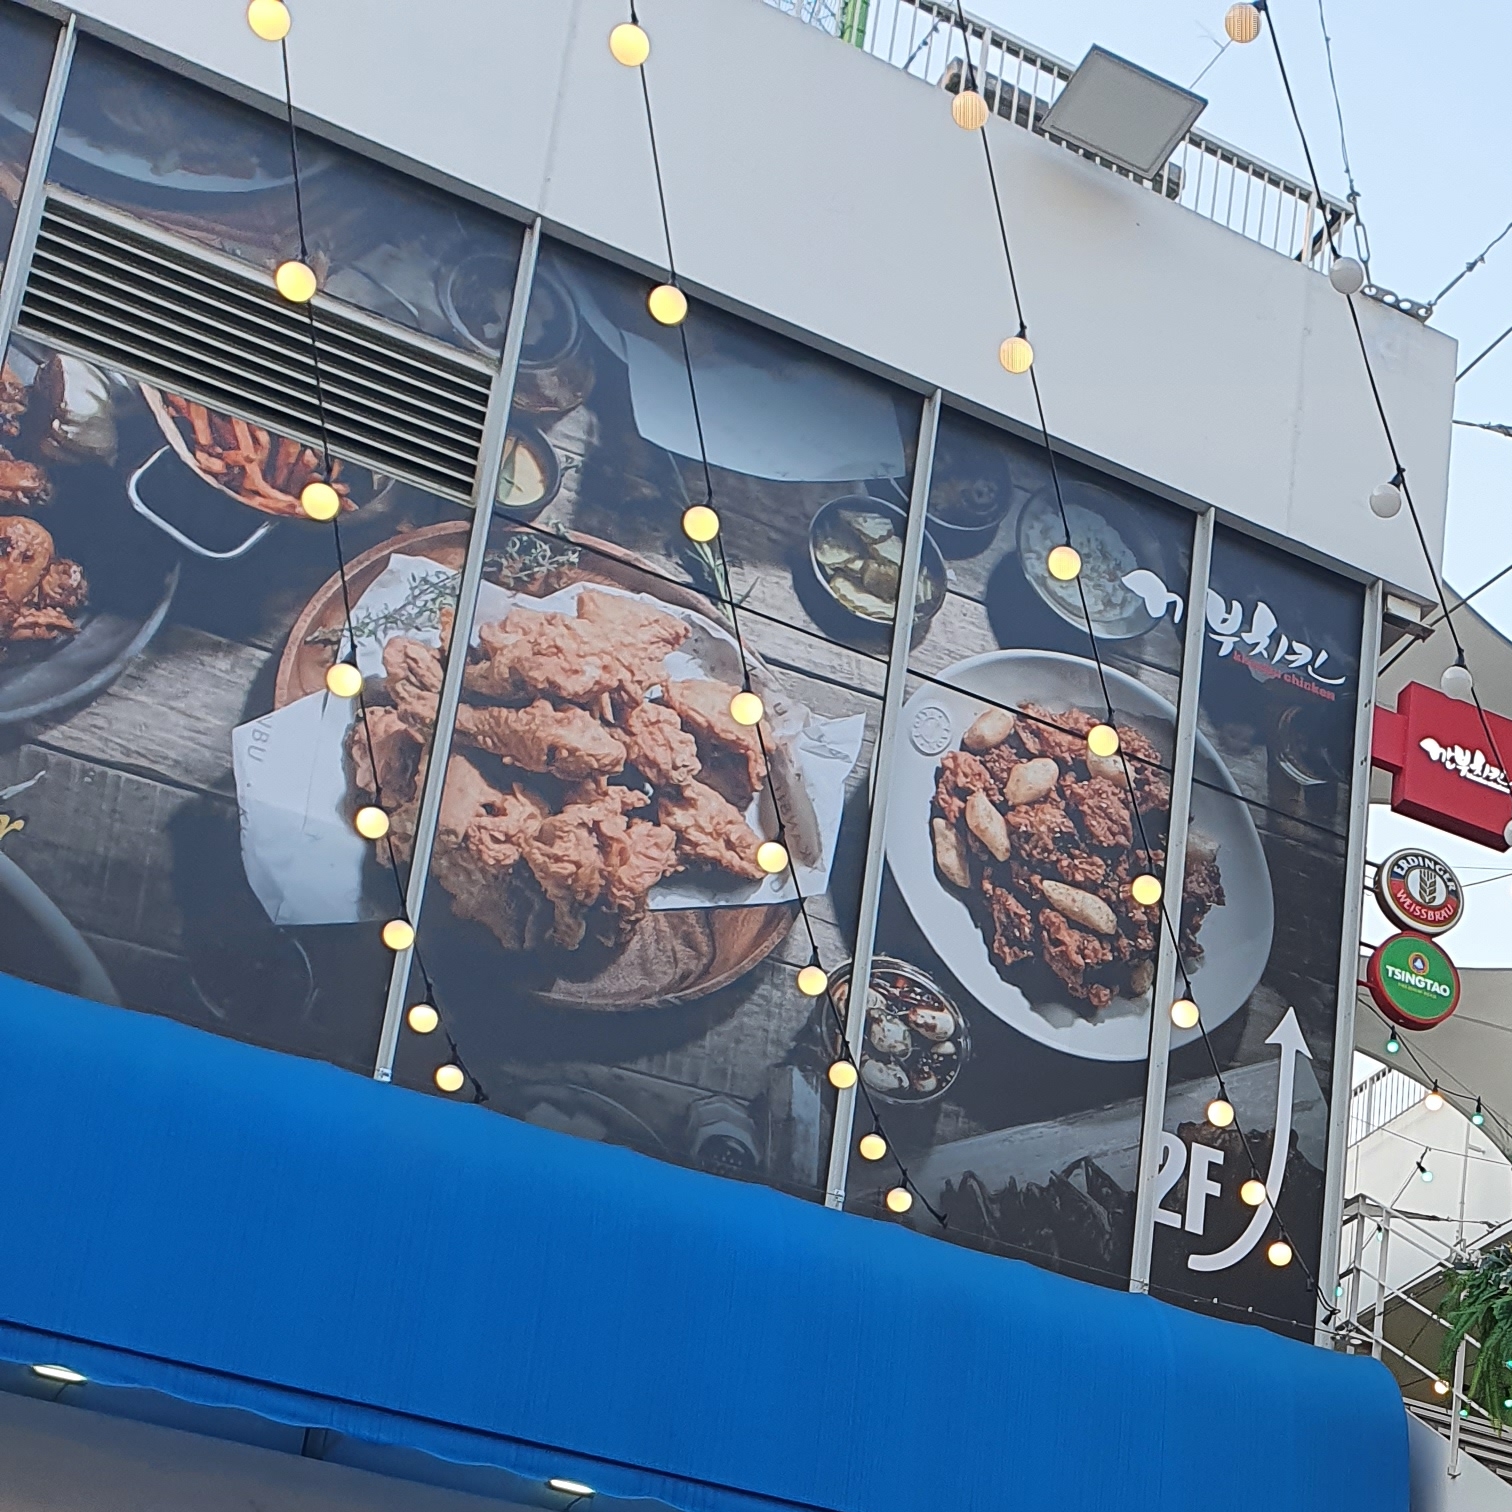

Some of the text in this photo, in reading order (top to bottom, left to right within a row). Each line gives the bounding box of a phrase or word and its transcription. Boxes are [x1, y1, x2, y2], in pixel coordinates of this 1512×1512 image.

[1393, 855, 1457, 891] ERDINGER
[1385, 964, 1451, 998] TSINGTAO
[1153, 1130, 1225, 1235] 2F
